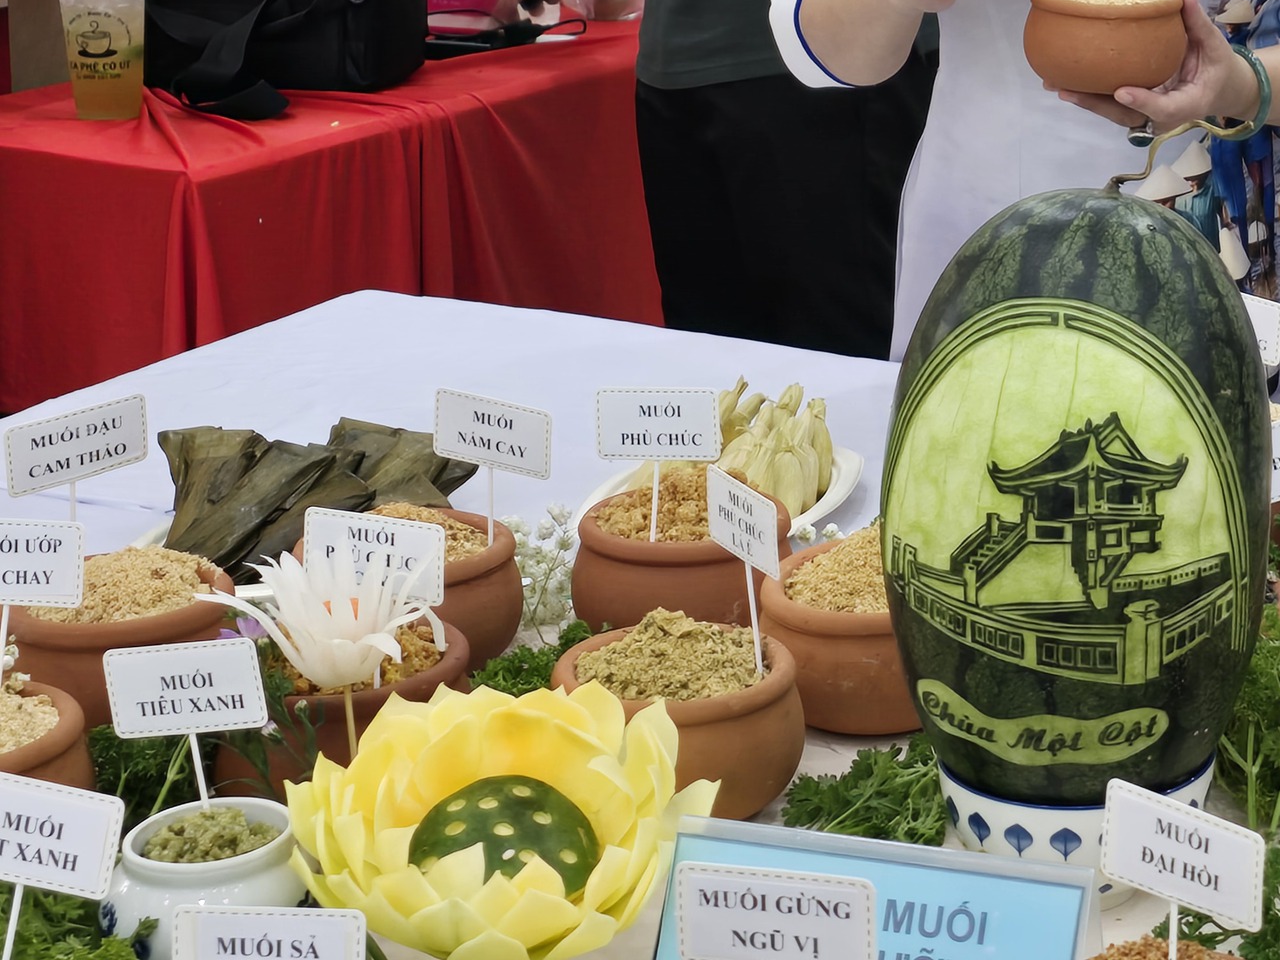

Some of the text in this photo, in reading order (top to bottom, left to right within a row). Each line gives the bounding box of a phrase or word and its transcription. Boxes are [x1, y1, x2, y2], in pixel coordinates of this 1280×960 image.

[620, 426, 703, 447] PHÙ CHÚC
[495, 439, 528, 459] CAY
[28, 457, 71, 478] CAM
[2, 570, 54, 585] CHAY
[136, 693, 245, 718] TIÊU XANH
[922, 691, 997, 743] Chùa
[13, 842, 79, 872] XANH
[1141, 845, 1176, 874] ĐẠI
[882, 898, 988, 946] MUỐI
[793, 935, 819, 959] VỊ
